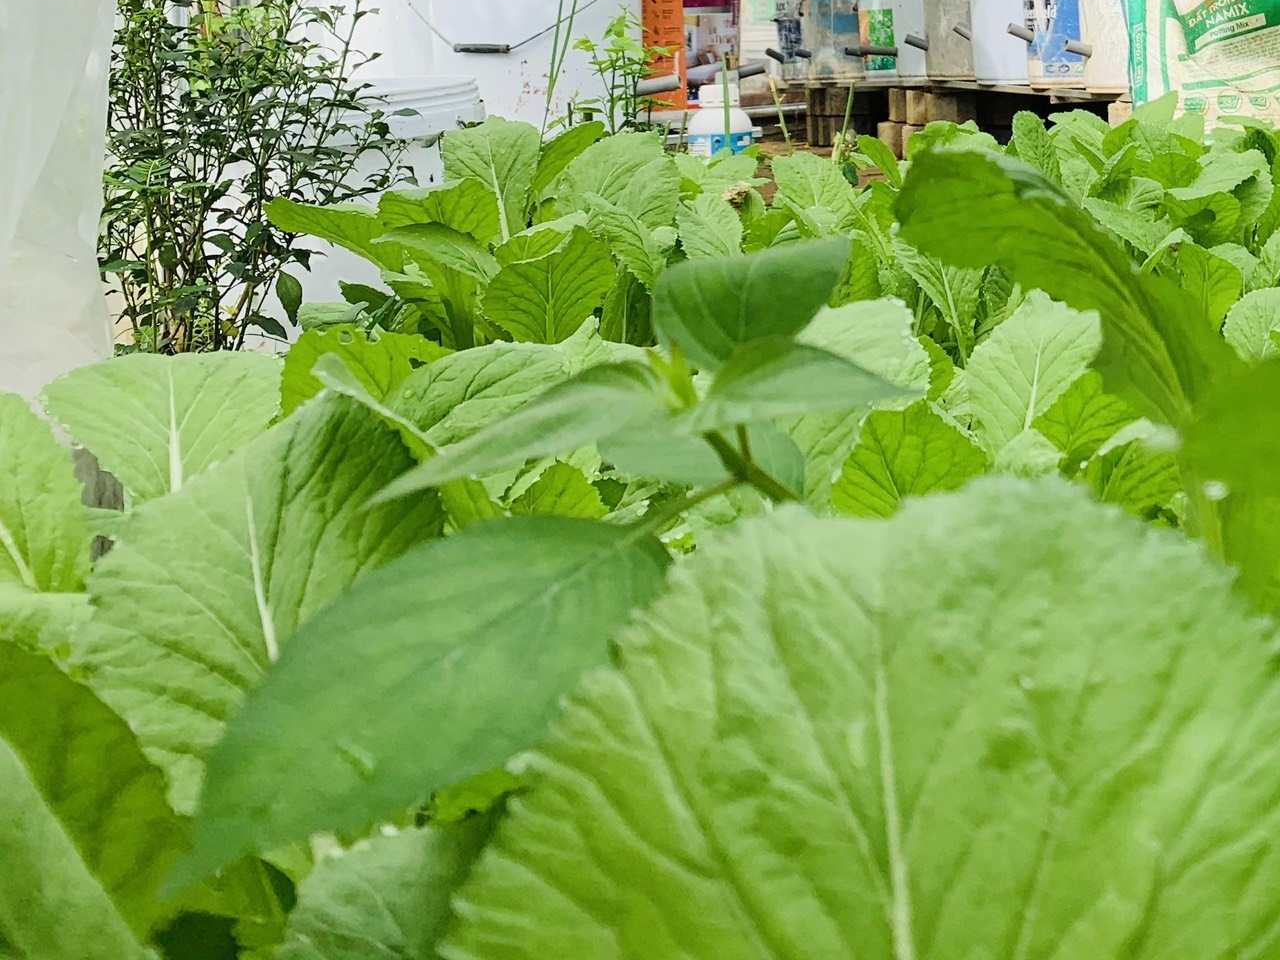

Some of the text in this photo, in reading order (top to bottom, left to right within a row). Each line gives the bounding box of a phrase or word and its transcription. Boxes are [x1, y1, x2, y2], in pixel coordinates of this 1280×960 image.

[1205, 2, 1250, 28] NAMIX
[1209, 20, 1250, 38] Potting Mix
